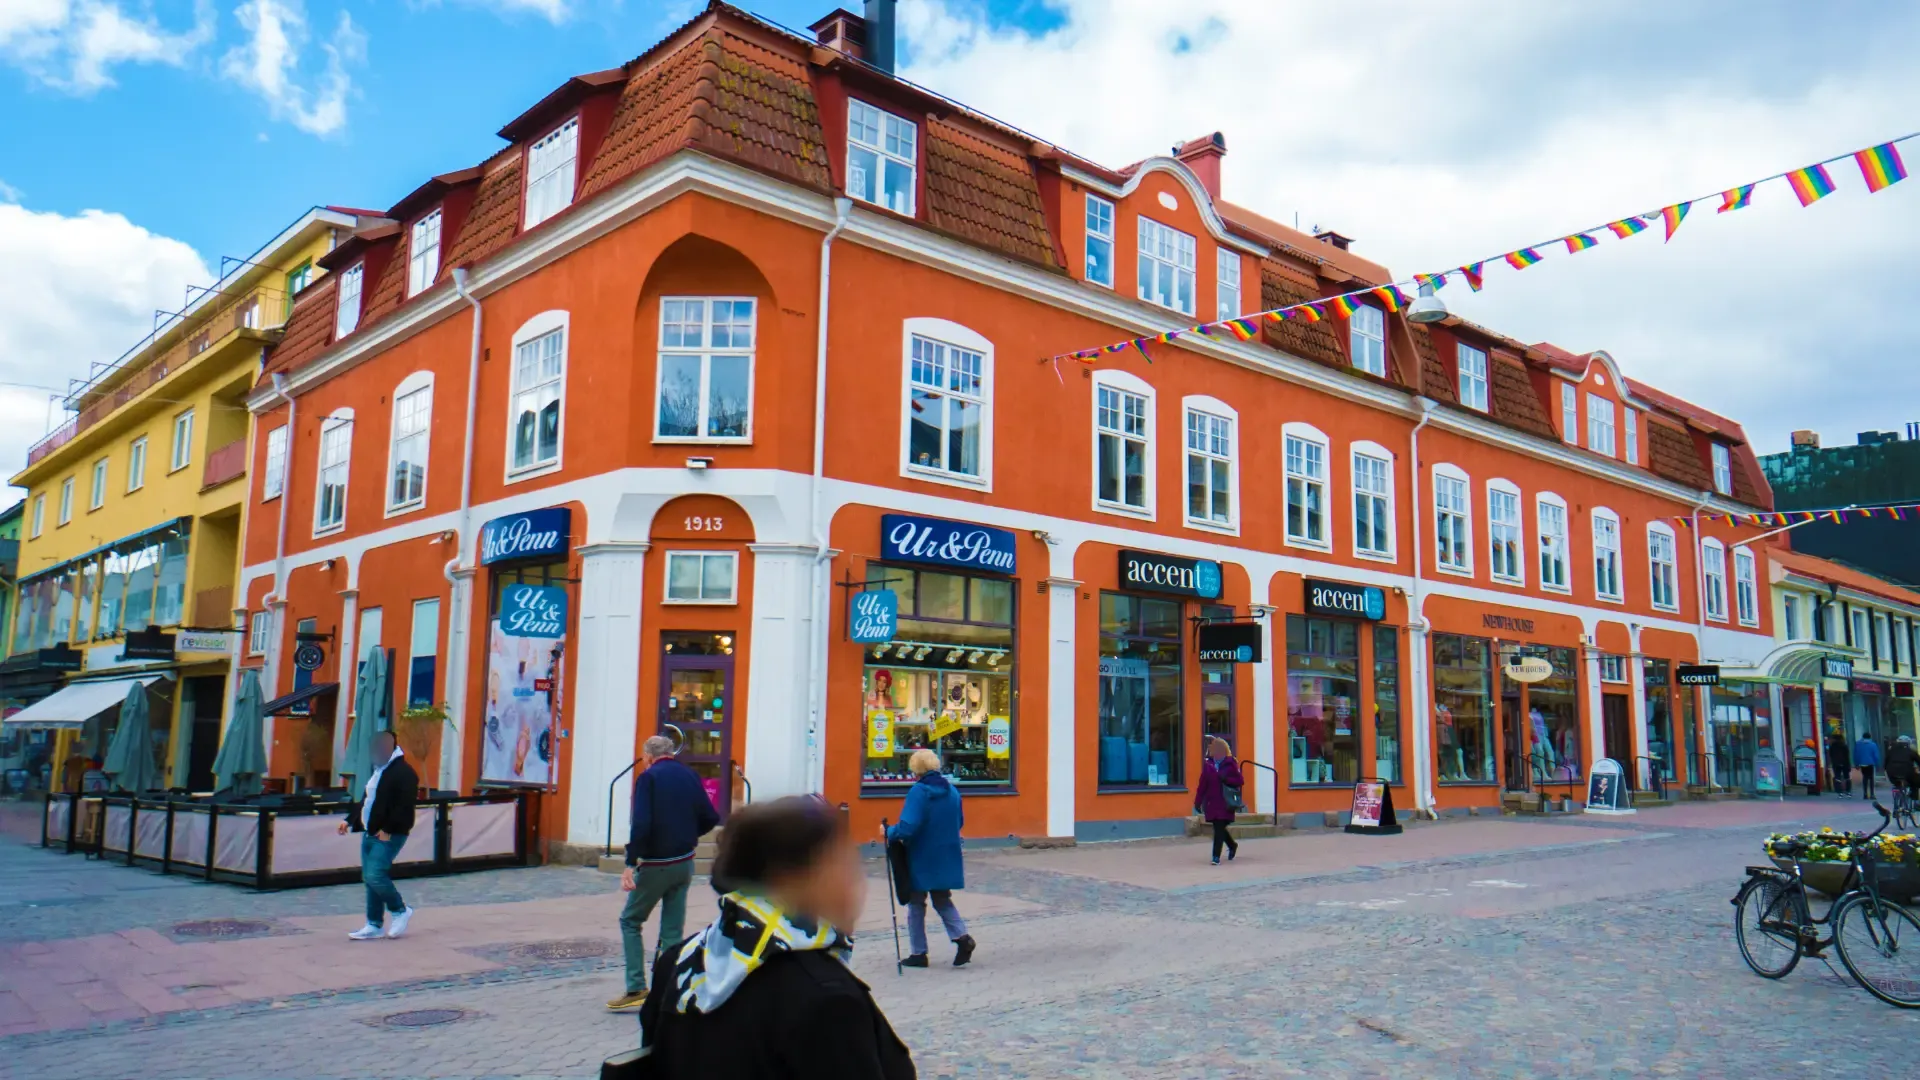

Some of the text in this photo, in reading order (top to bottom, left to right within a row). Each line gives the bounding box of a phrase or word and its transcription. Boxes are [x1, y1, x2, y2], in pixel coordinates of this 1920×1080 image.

[684, 516, 723, 531] 1913
[1127, 560, 1204, 589] accent
[514, 588, 548, 610] Ur
[857, 594, 880, 616] Ur
[1313, 588, 1370, 612] accent
[505, 609, 560, 634] Penn
[853, 616, 890, 638] Penn
[1483, 614, 1534, 633] NEWHOUSE
[181, 637, 227, 649] revision
[1200, 649, 1240, 660] accent
[1681, 675, 1717, 683] SCORETT
[989, 735, 1007, 744] 150:-
